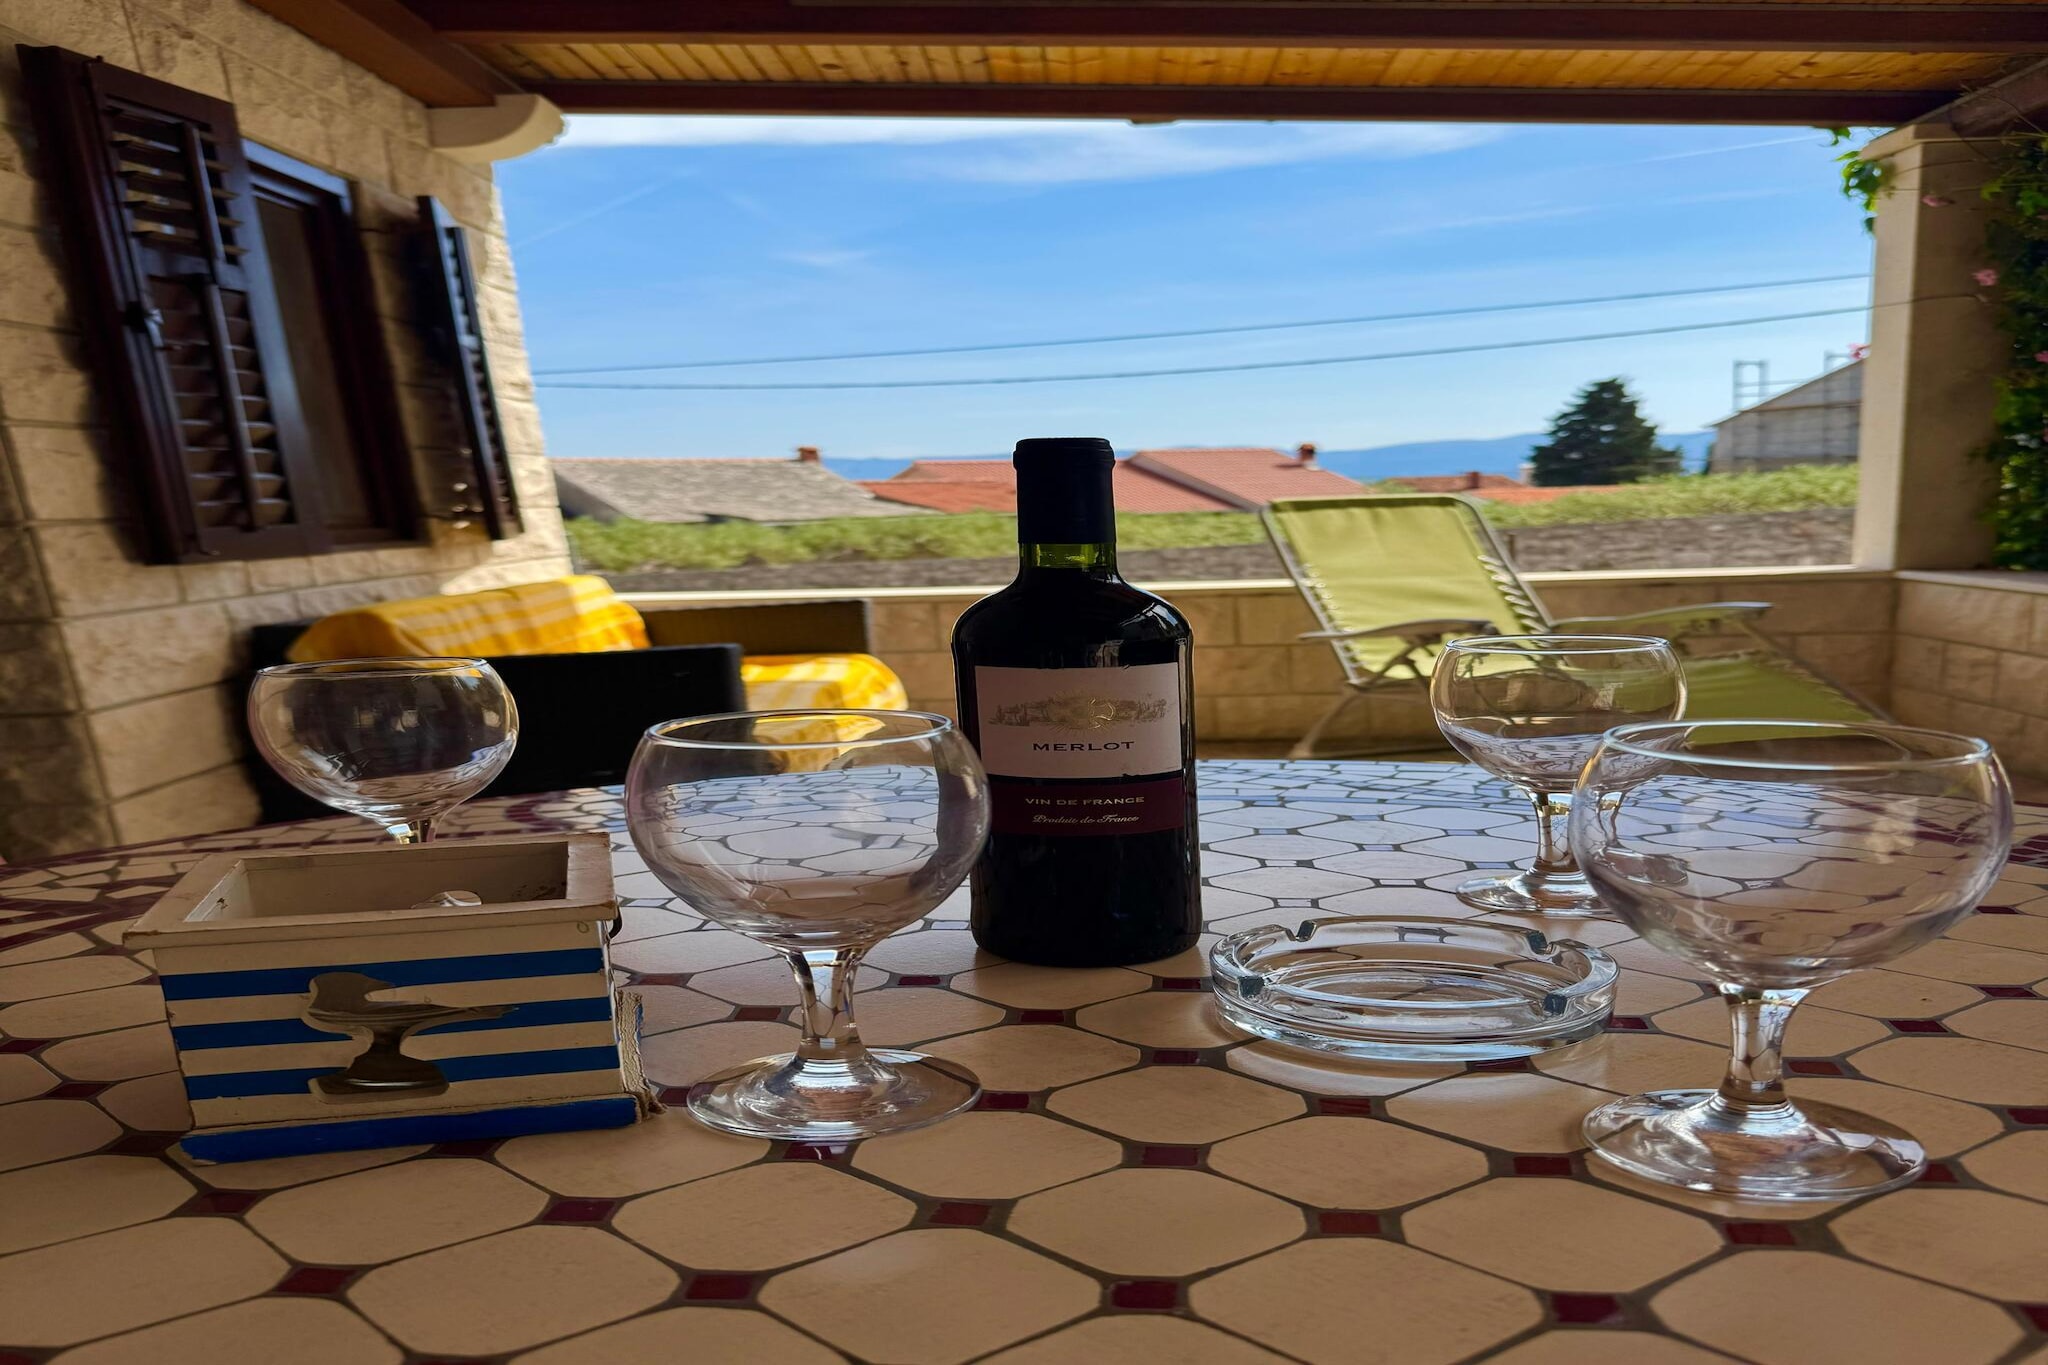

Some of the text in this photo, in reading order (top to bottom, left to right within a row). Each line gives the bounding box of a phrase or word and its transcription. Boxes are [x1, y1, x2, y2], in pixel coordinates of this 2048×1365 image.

[1032, 741, 1135, 752] MERLOT
[1025, 798, 1051, 806] VIN
[1083, 796, 1145, 806] FRANCE
[1031, 813, 1140, 824] Produit de France
